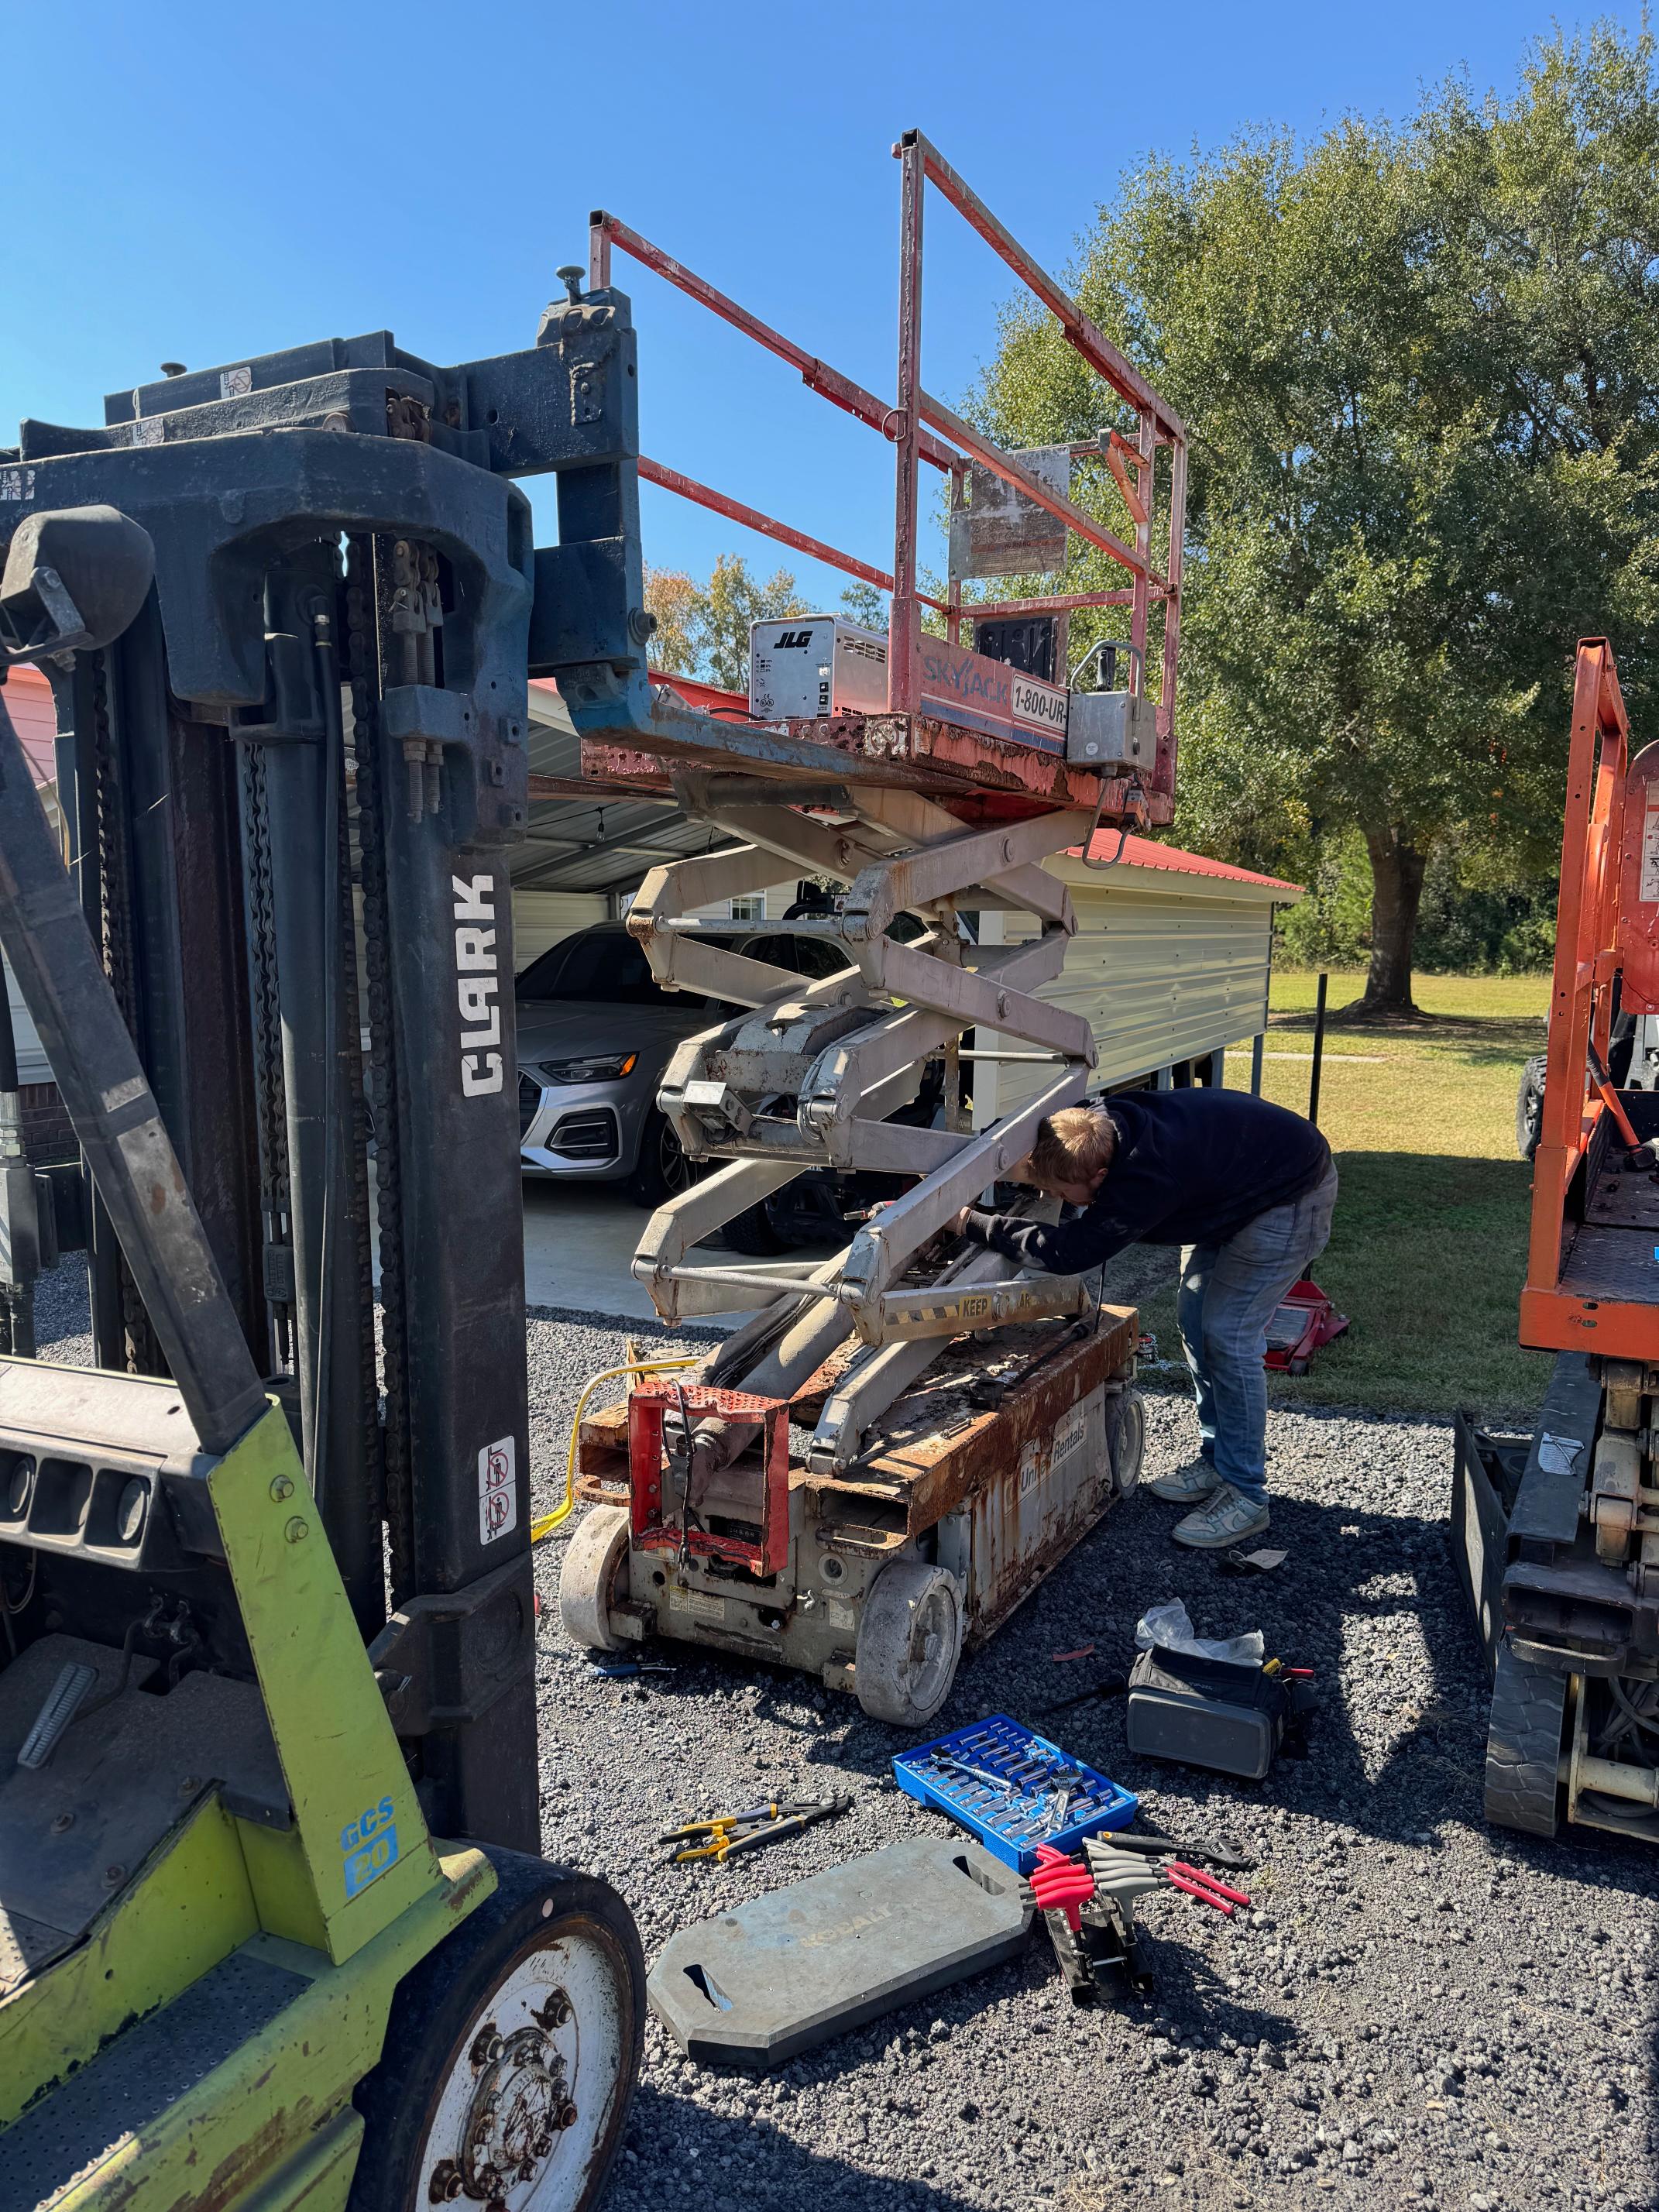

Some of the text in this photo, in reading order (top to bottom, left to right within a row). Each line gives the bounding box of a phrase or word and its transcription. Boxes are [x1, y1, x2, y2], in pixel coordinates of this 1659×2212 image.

[774, 630, 813, 649] JLG
[924, 657, 1008, 706] SKYJACK
[452, 874, 503, 1098] CLARK
[963, 1298, 988, 1317] KEEP
[1053, 1422, 1084, 1464] Rentals
[340, 1796, 394, 1852] GCS
[354, 1839, 389, 1884] 20
